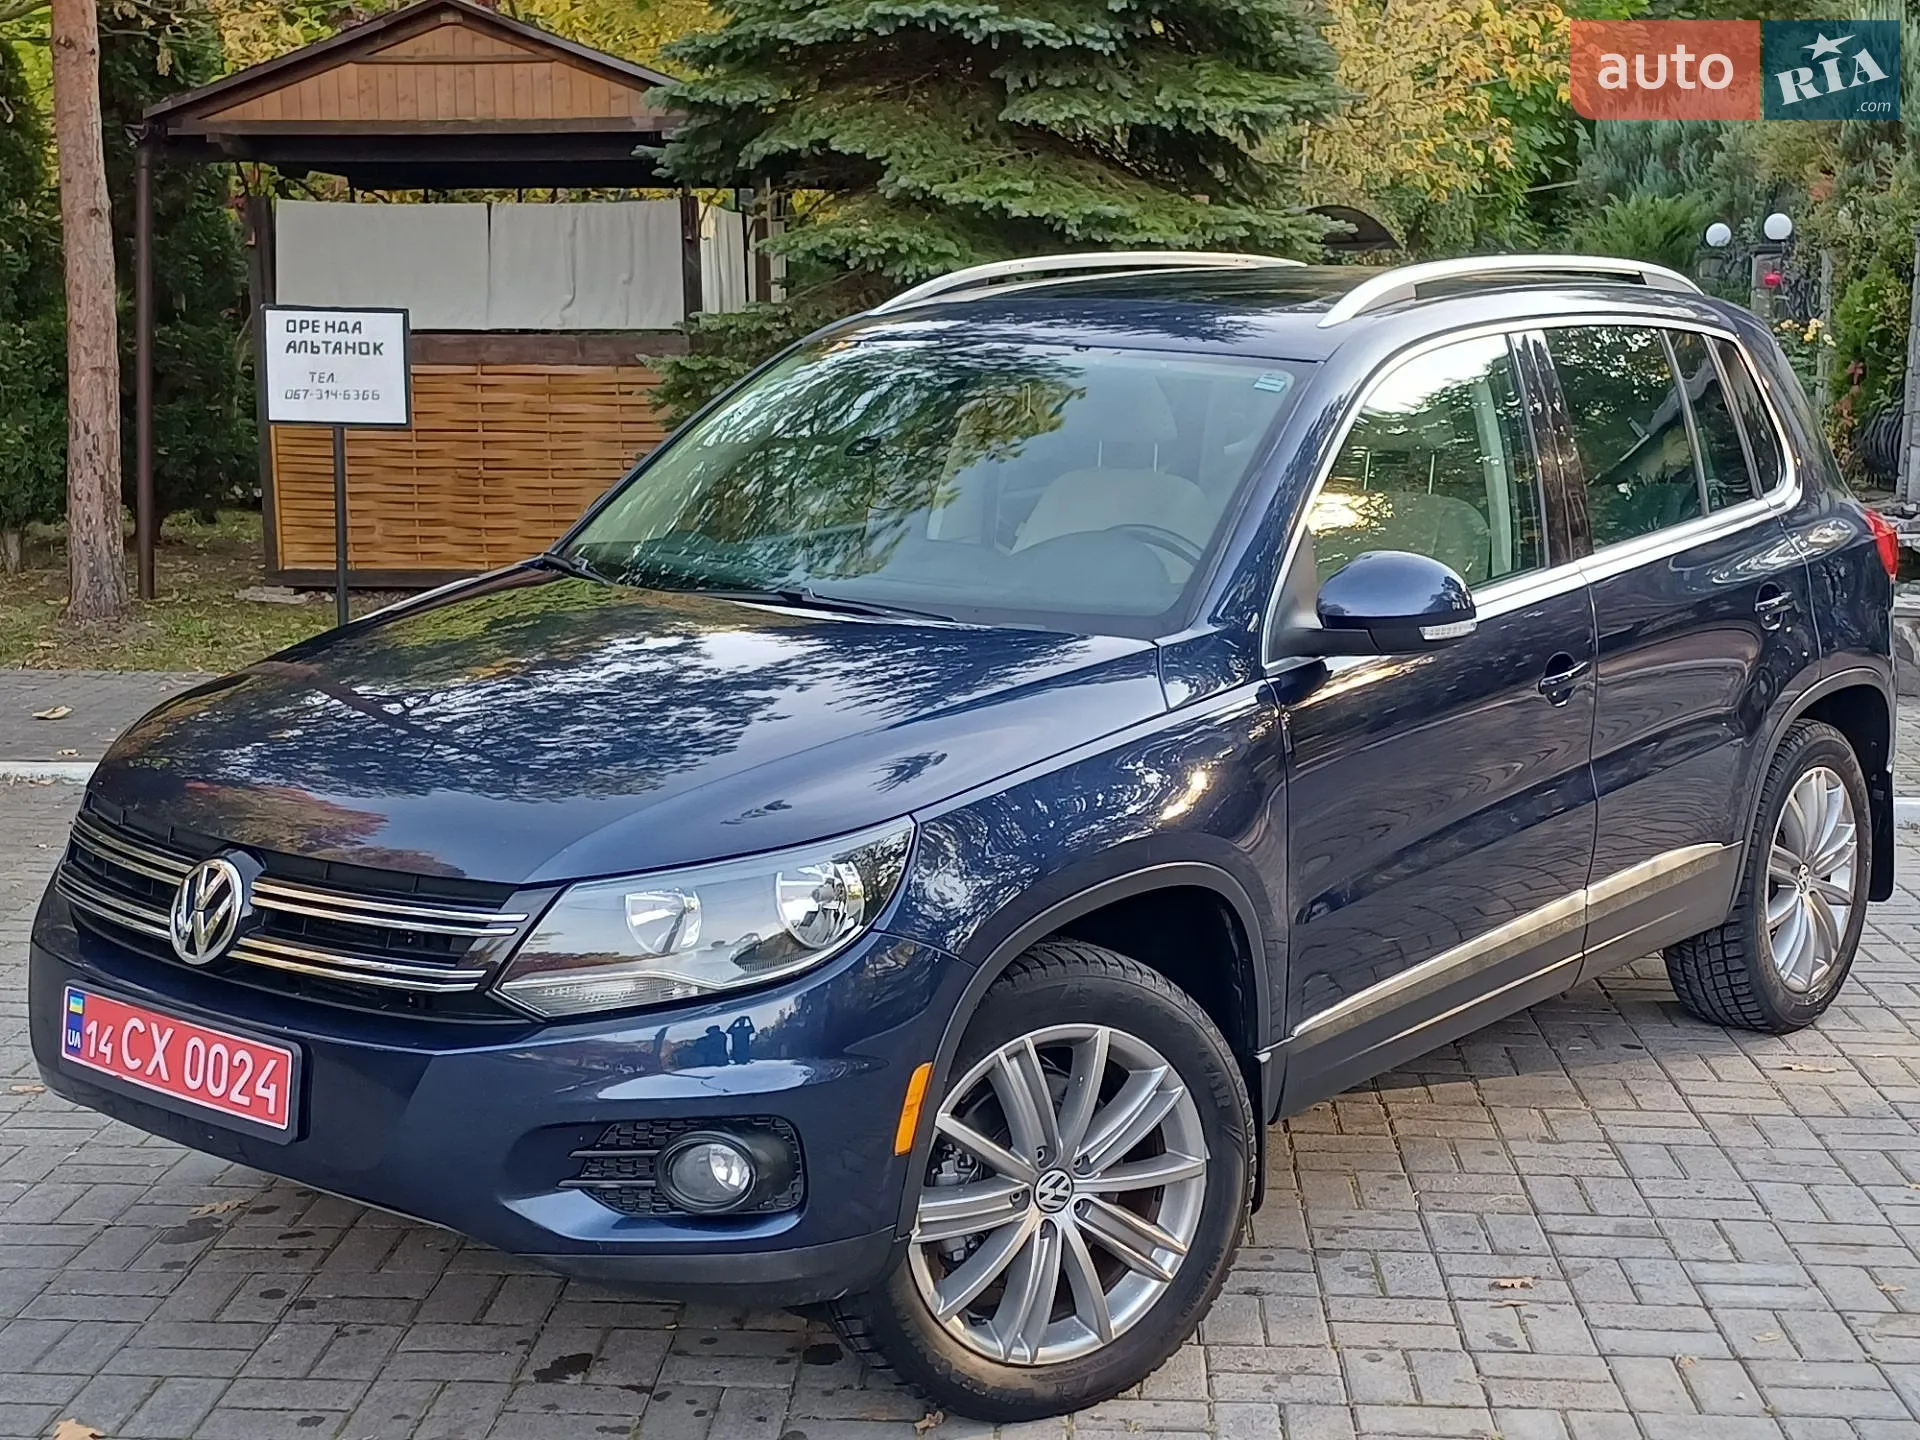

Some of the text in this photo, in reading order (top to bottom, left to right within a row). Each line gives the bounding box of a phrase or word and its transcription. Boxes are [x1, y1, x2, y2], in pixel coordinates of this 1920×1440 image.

[286, 319, 362, 334] ОРЕНДА
[285, 340, 384, 356] АЛЬТАНОК
[67, 1028, 82, 1049] UA
[86, 1017, 279, 1116] 14 CX 0024
